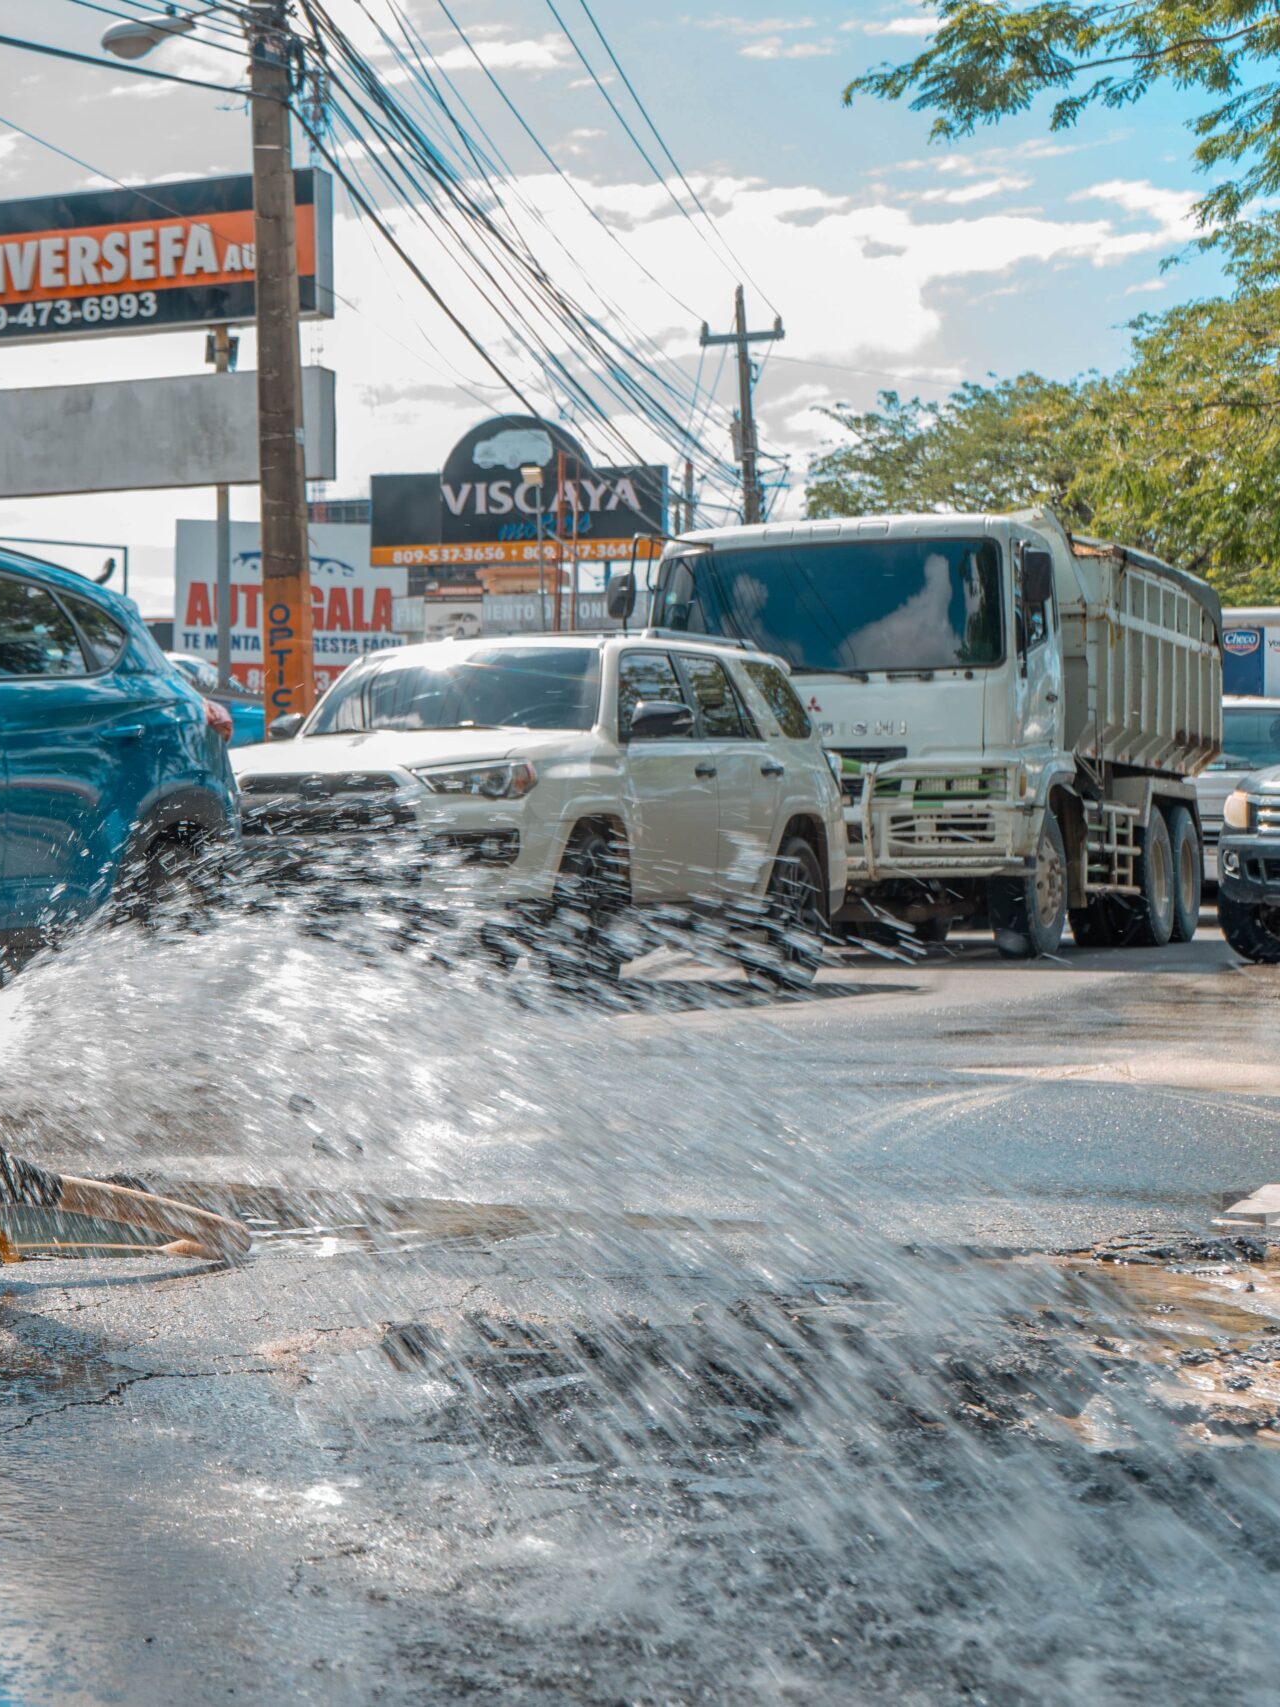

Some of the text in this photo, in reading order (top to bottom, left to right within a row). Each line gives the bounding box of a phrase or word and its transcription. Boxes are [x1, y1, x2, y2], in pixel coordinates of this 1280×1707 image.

[222, 243, 255, 272] AU
[440, 477, 642, 516] VISCAYA
[392, 546, 505, 564] 809-537-3656
[185, 582, 263, 628] AUT
[182, 633, 200, 649] TE
[205, 634, 261, 651] MNTA
[313, 637, 359, 654] RESTA
[268, 603, 294, 718] OPTIC
